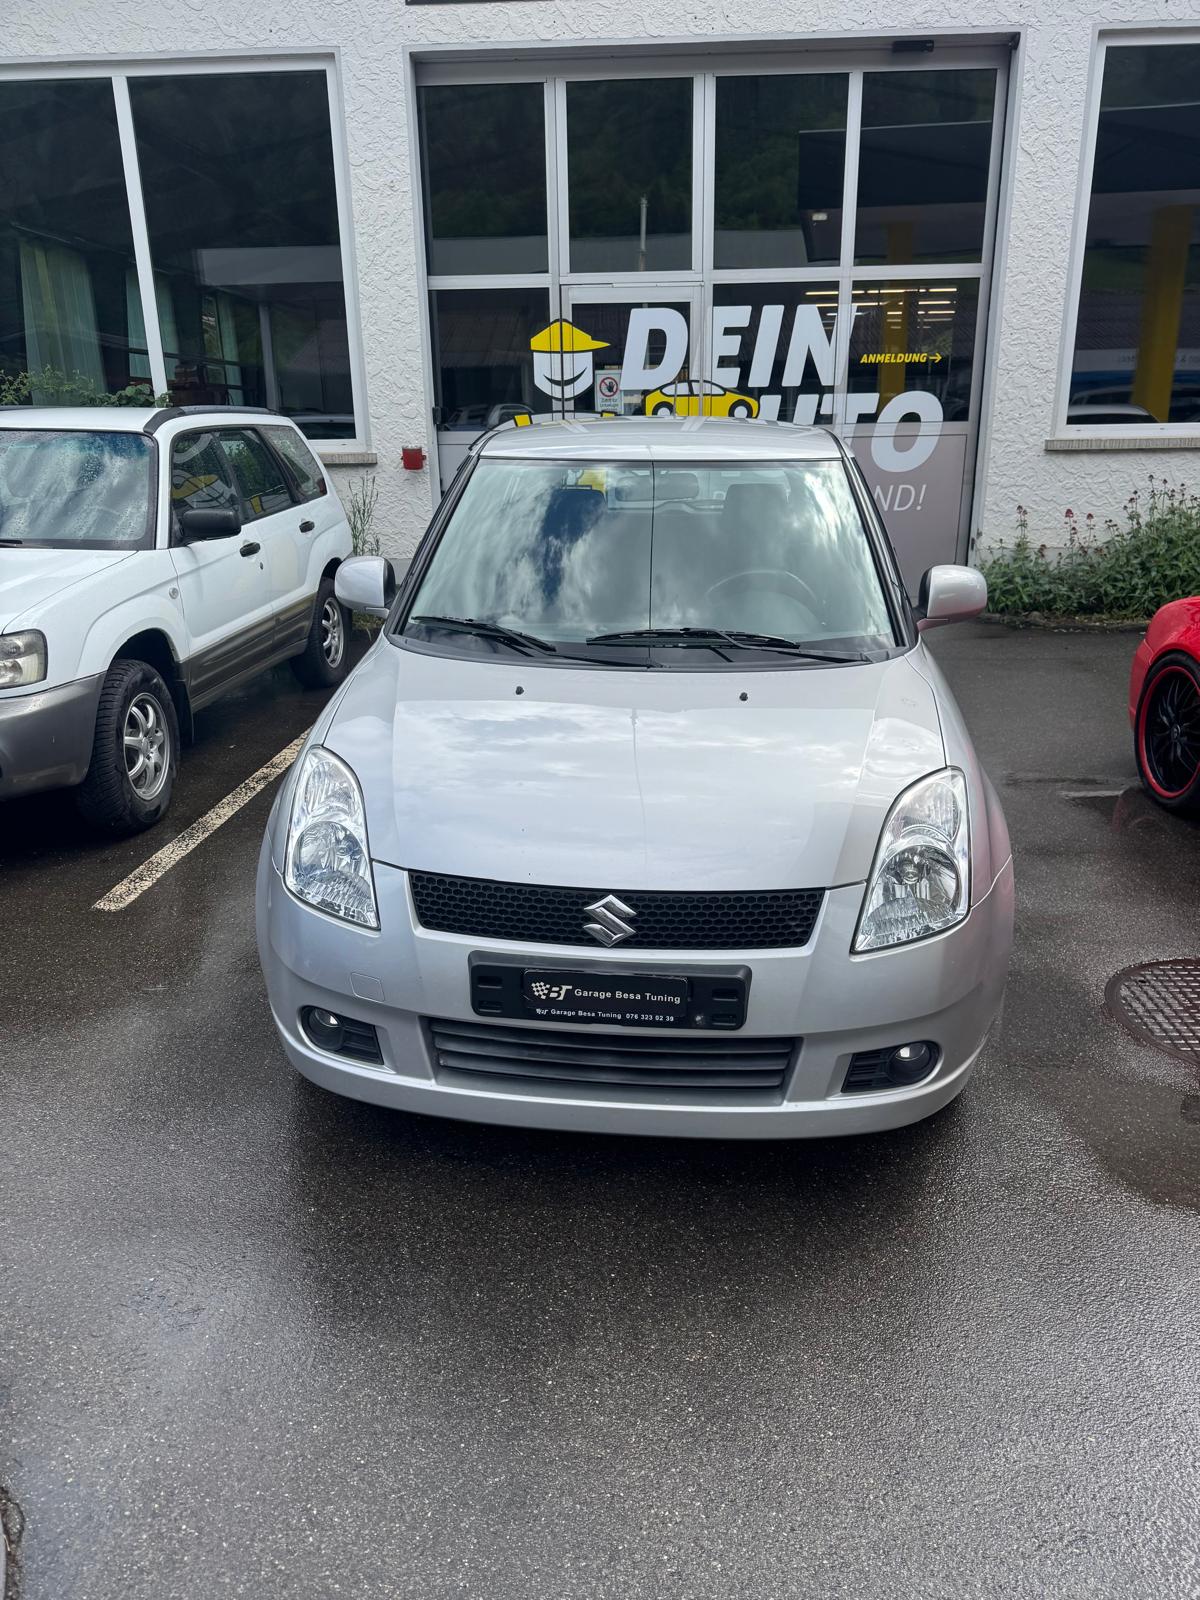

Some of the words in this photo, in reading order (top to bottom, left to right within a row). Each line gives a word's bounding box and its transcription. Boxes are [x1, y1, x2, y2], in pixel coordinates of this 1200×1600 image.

[620, 304, 857, 390] DEIN
[860, 353, 927, 363] ANMELDUNG
[574, 988, 612, 999] Garage
[615, 990, 641, 1000] Besa
[645, 992, 681, 1004] Tuning
[550, 1008, 576, 1016] Garage
[597, 1011, 622, 1019] Tuning
